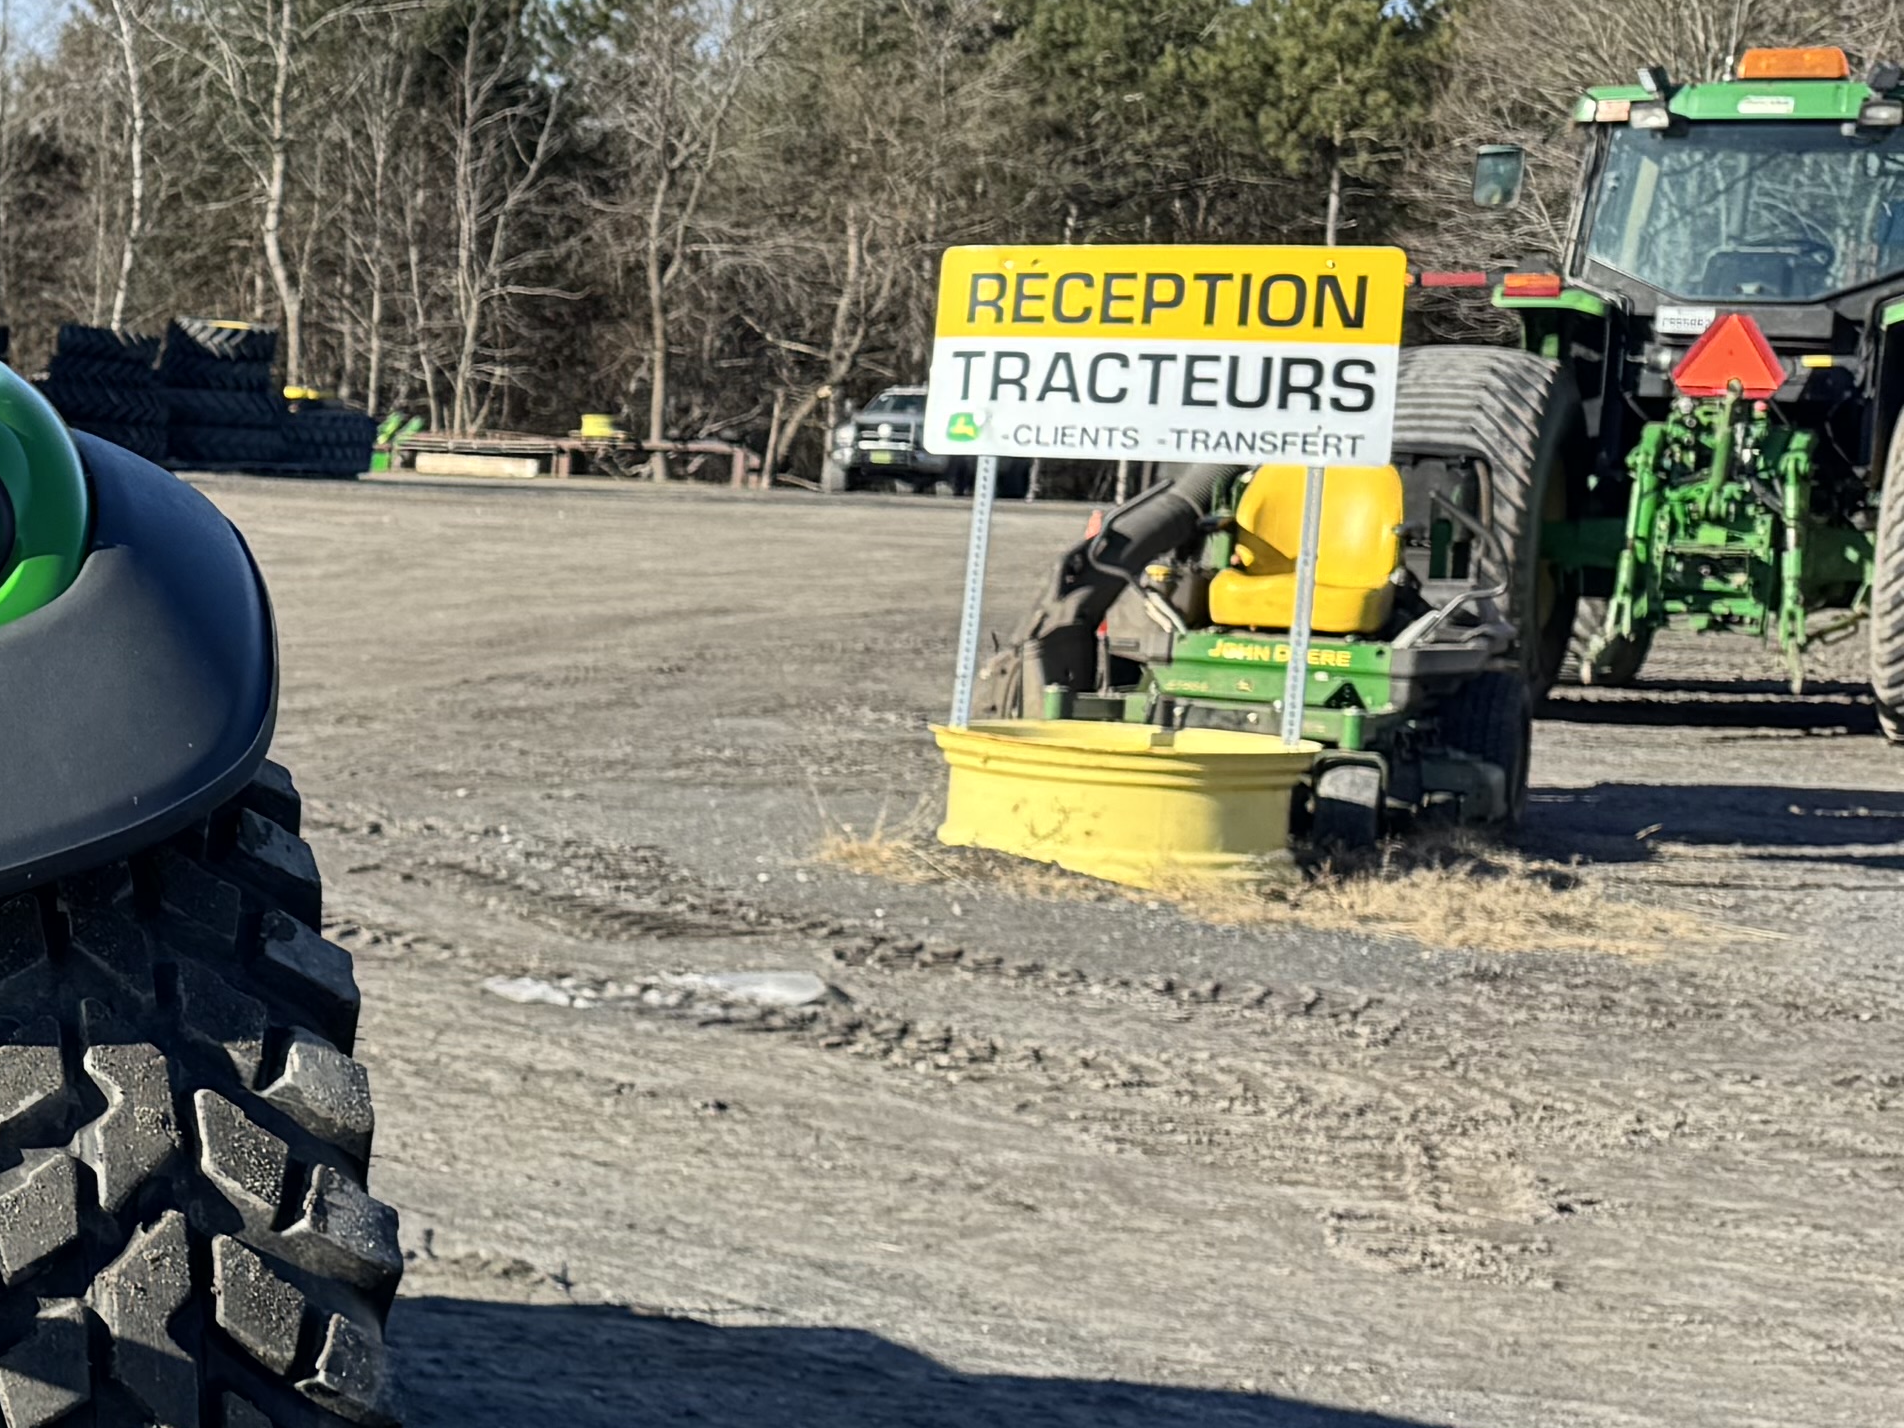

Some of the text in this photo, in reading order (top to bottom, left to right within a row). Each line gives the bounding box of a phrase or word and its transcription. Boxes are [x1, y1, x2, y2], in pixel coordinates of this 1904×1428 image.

[952, 350, 1376, 412] TRACTEURS
[1208, 639, 1352, 668] JOHN DERE
